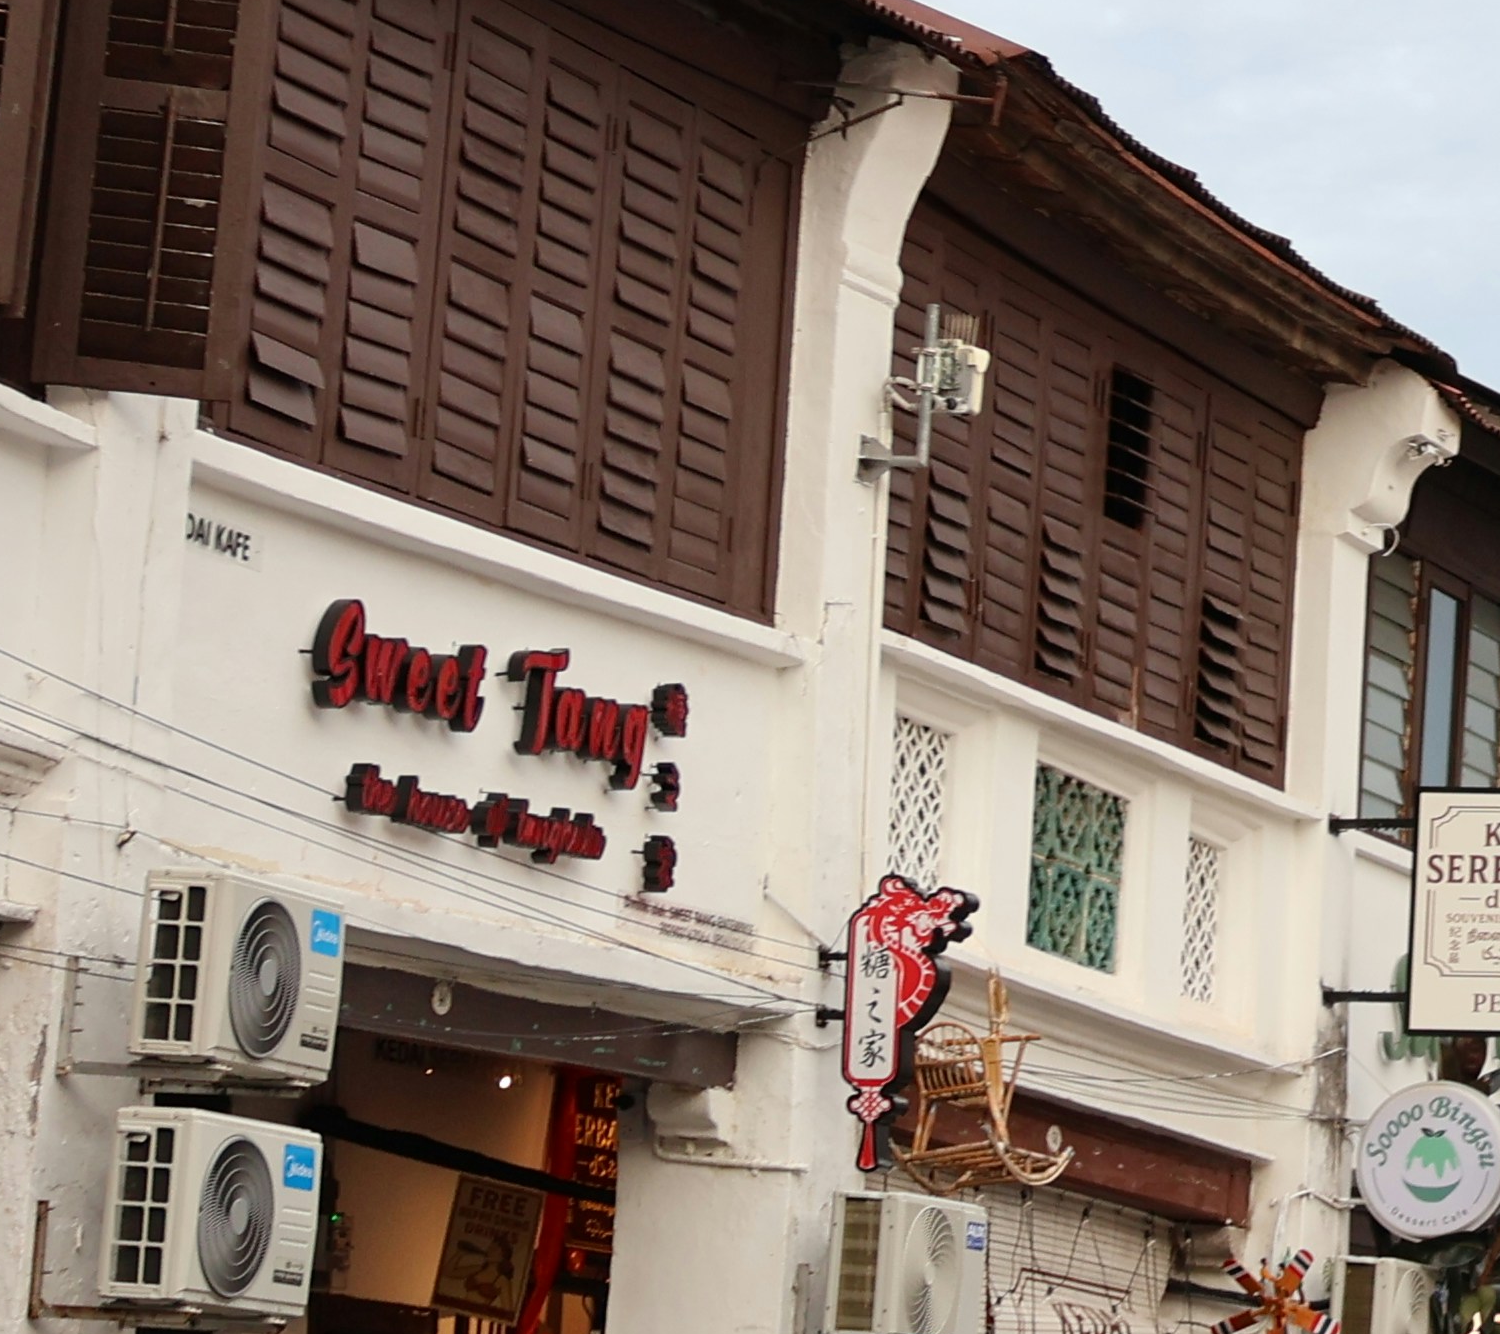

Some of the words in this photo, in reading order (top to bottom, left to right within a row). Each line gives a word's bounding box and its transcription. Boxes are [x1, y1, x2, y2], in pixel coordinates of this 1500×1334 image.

[214, 524, 251, 561] KAFE
[311, 599, 488, 732] Sweet
[506, 648, 649, 790] Tang
[858, 946, 890, 1068] 糖之家
[1366, 1104, 1424, 1166] Soooo
[1429, 1096, 1495, 1169] Bingsu
[469, 1186, 528, 1217] FREE
[1391, 1206, 1437, 1227] Dessert
[463, 1221, 519, 1245] DRINKS
